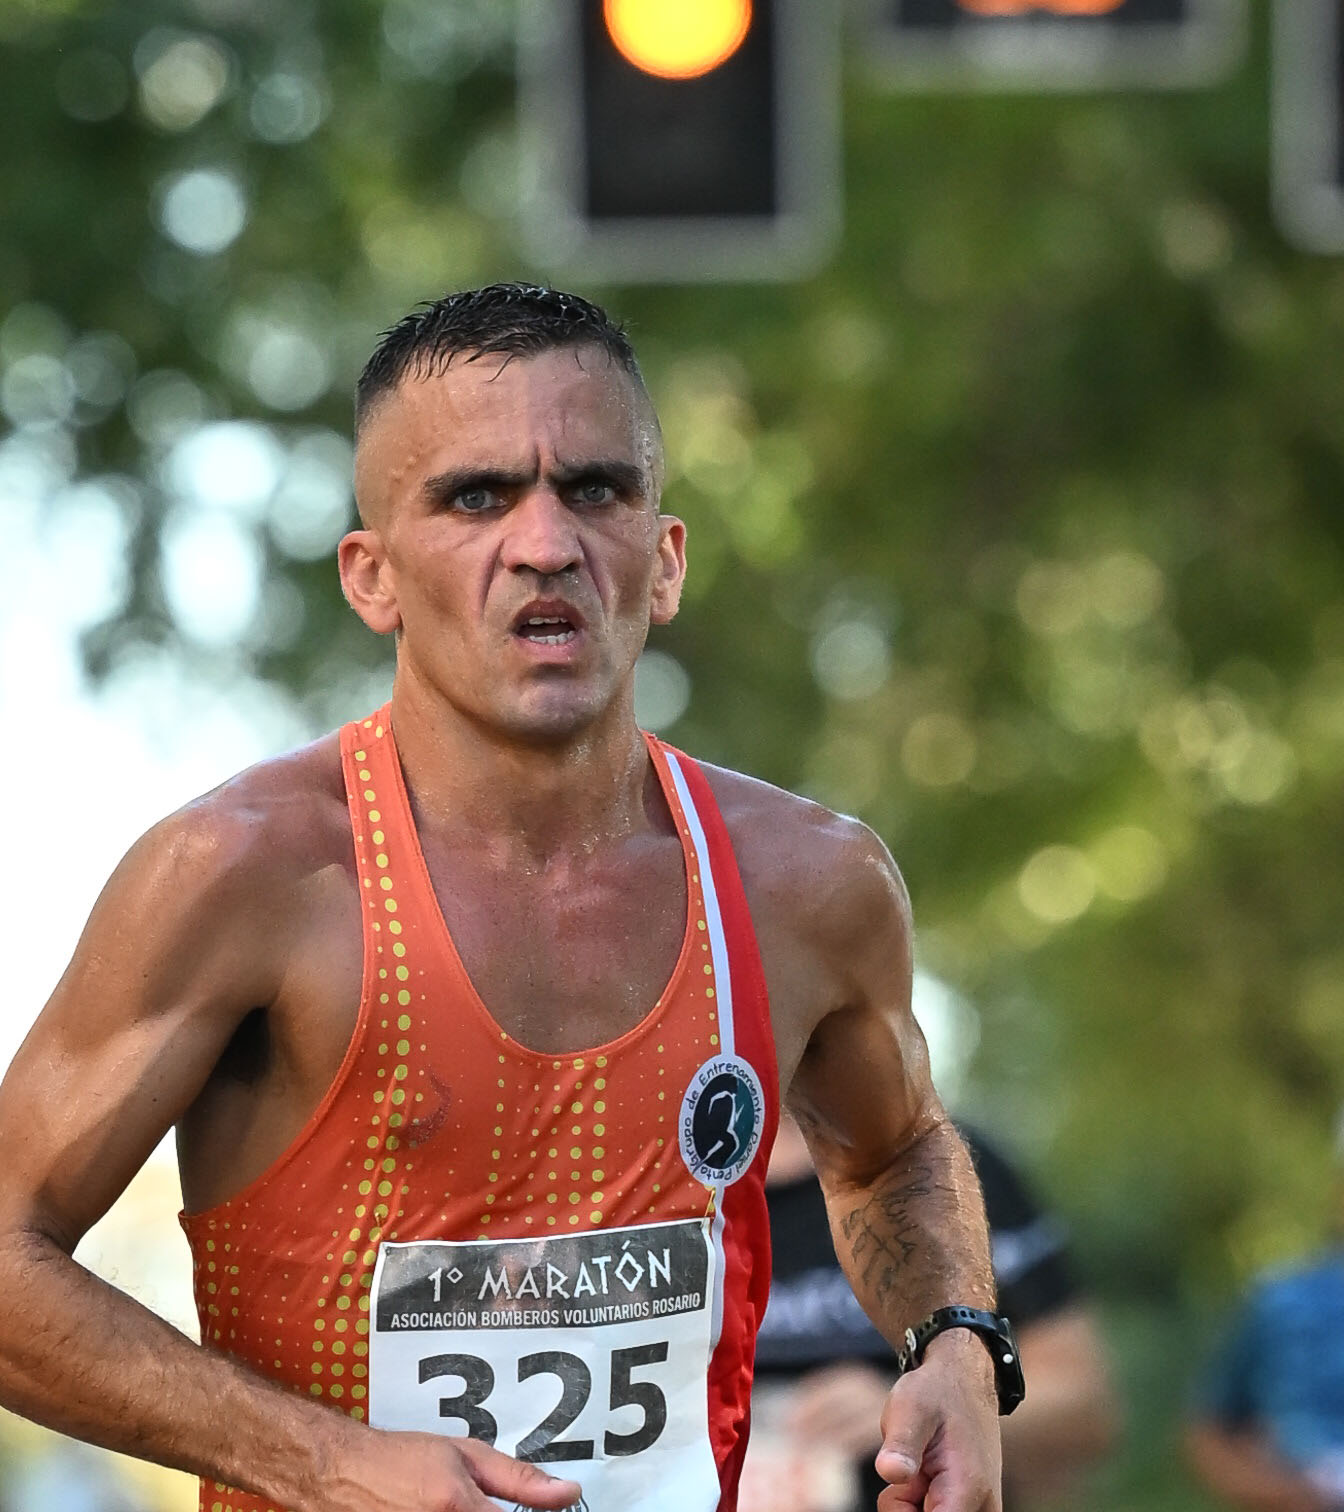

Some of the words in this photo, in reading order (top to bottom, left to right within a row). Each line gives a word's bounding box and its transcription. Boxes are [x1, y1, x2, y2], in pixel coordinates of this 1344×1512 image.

[685, 1090, 700, 1110] de
[684, 1117, 701, 1167] Grupo
[477, 1239, 672, 1301] MARATÓN
[390, 1308, 477, 1329] ASOCIACIÓN
[480, 1308, 560, 1327] BOMBEROS
[564, 1301, 650, 1325] VOLUNTARIOS
[652, 1291, 701, 1314] ROSARIO
[417, 1340, 670, 1464] 325
